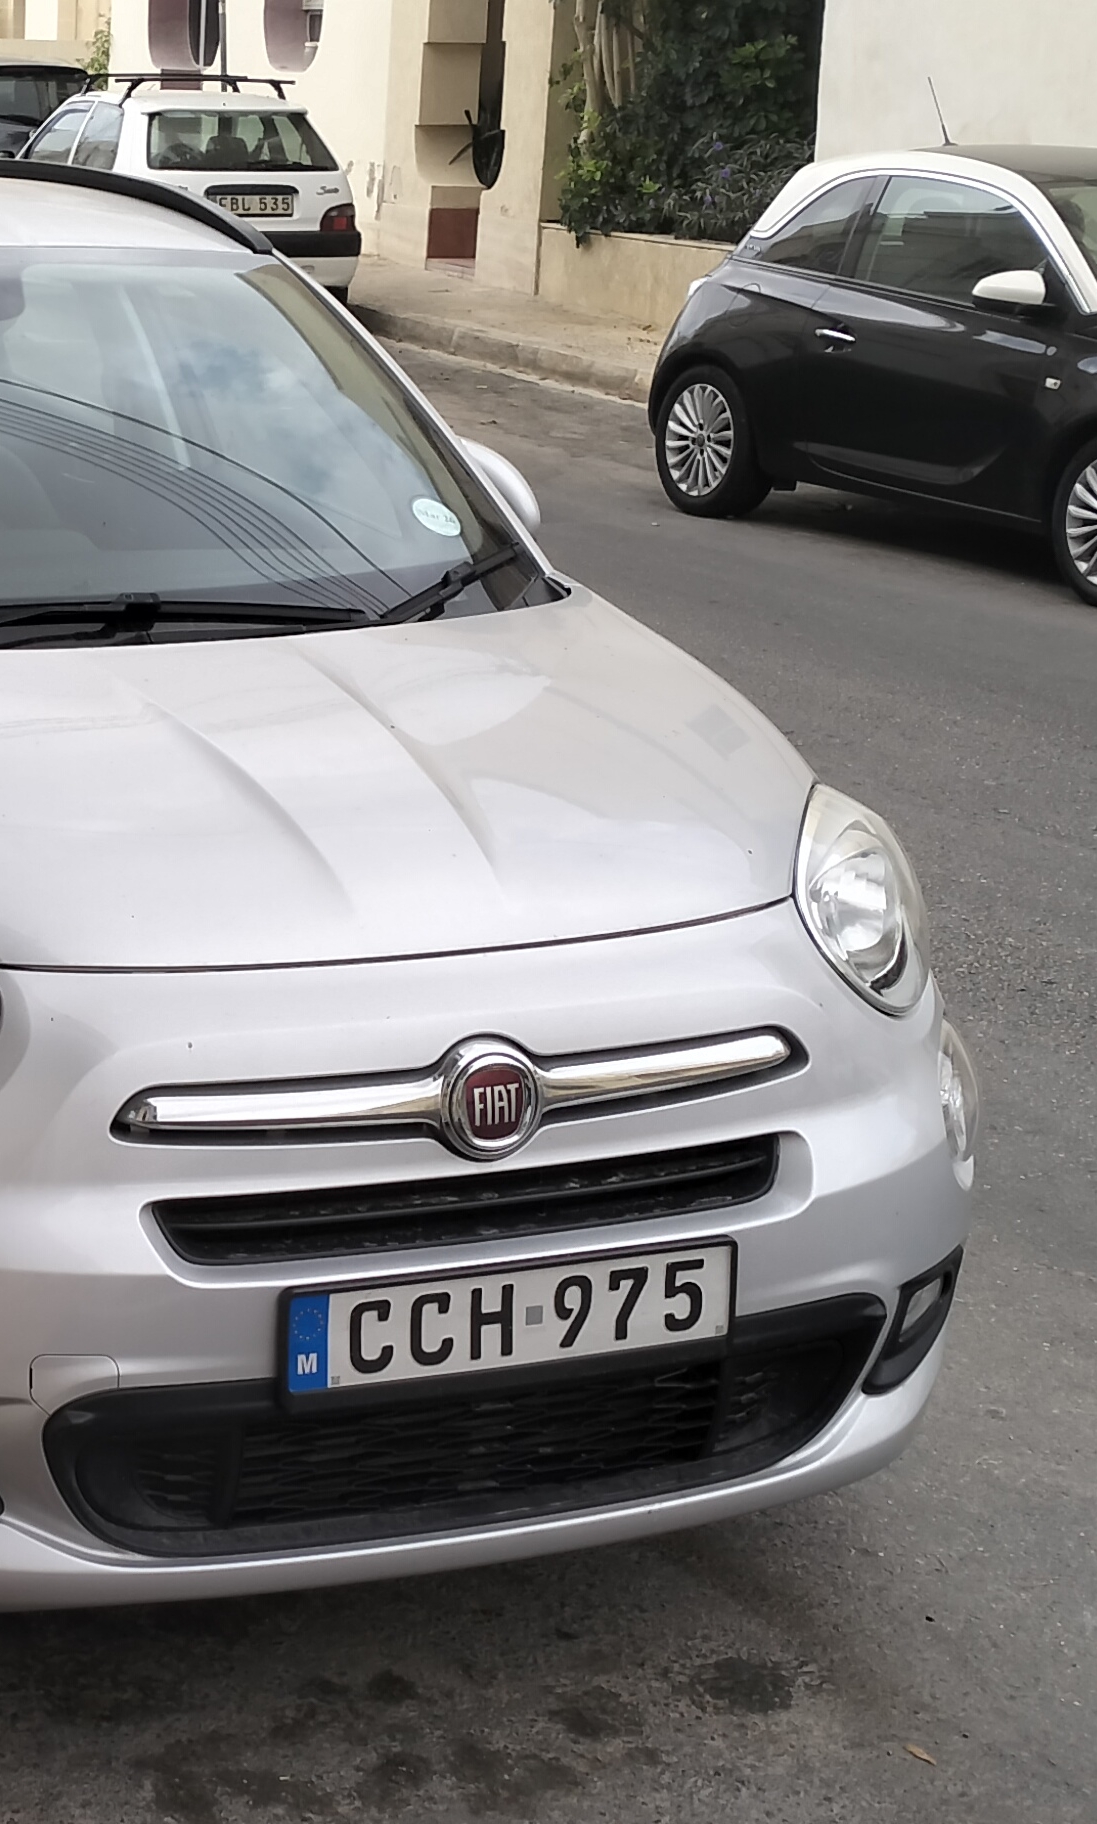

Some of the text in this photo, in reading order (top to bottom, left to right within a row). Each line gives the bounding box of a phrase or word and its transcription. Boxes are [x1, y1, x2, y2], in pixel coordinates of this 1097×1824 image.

[259, 197, 290, 211] 535
[473, 1083, 519, 1127] FIAT
[349, 1258, 705, 1373] CCH 975
[297, 1352, 318, 1375] M
